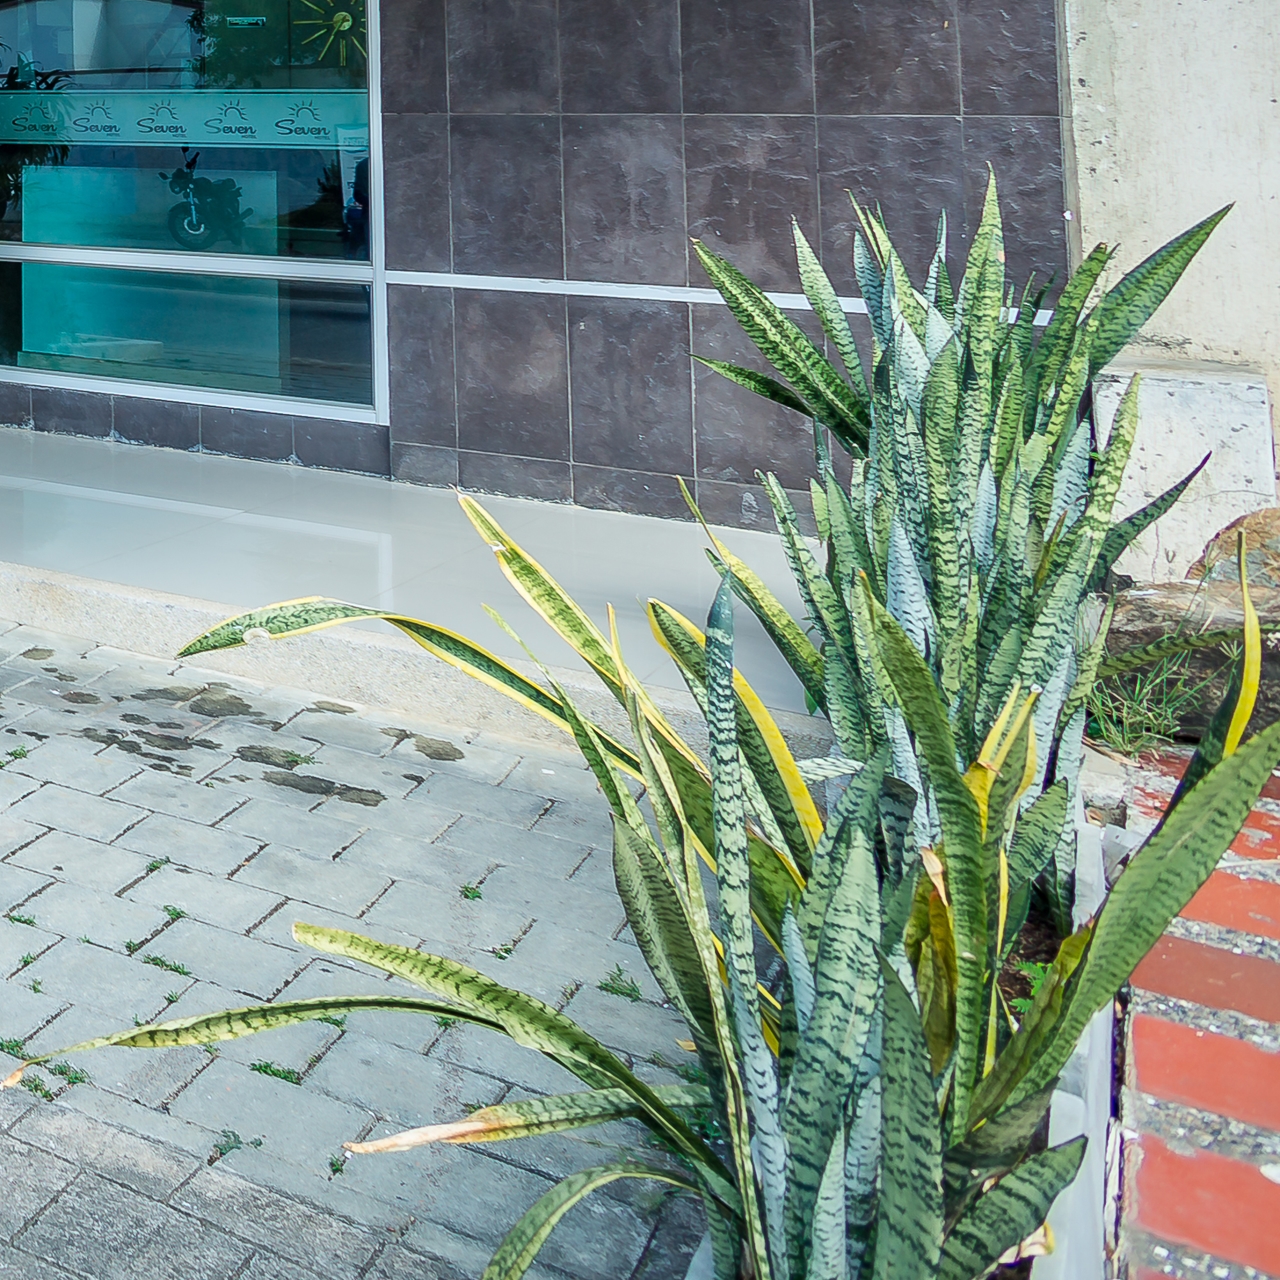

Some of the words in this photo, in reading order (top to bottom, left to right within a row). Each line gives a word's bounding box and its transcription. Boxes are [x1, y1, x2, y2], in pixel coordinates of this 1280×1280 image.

[12, 117, 57, 132] Seven
[73, 117, 121, 133] Seven
[136, 117, 187, 134] Seven
[204, 118, 257, 135] Seven
[274, 118, 330, 136] Seven
